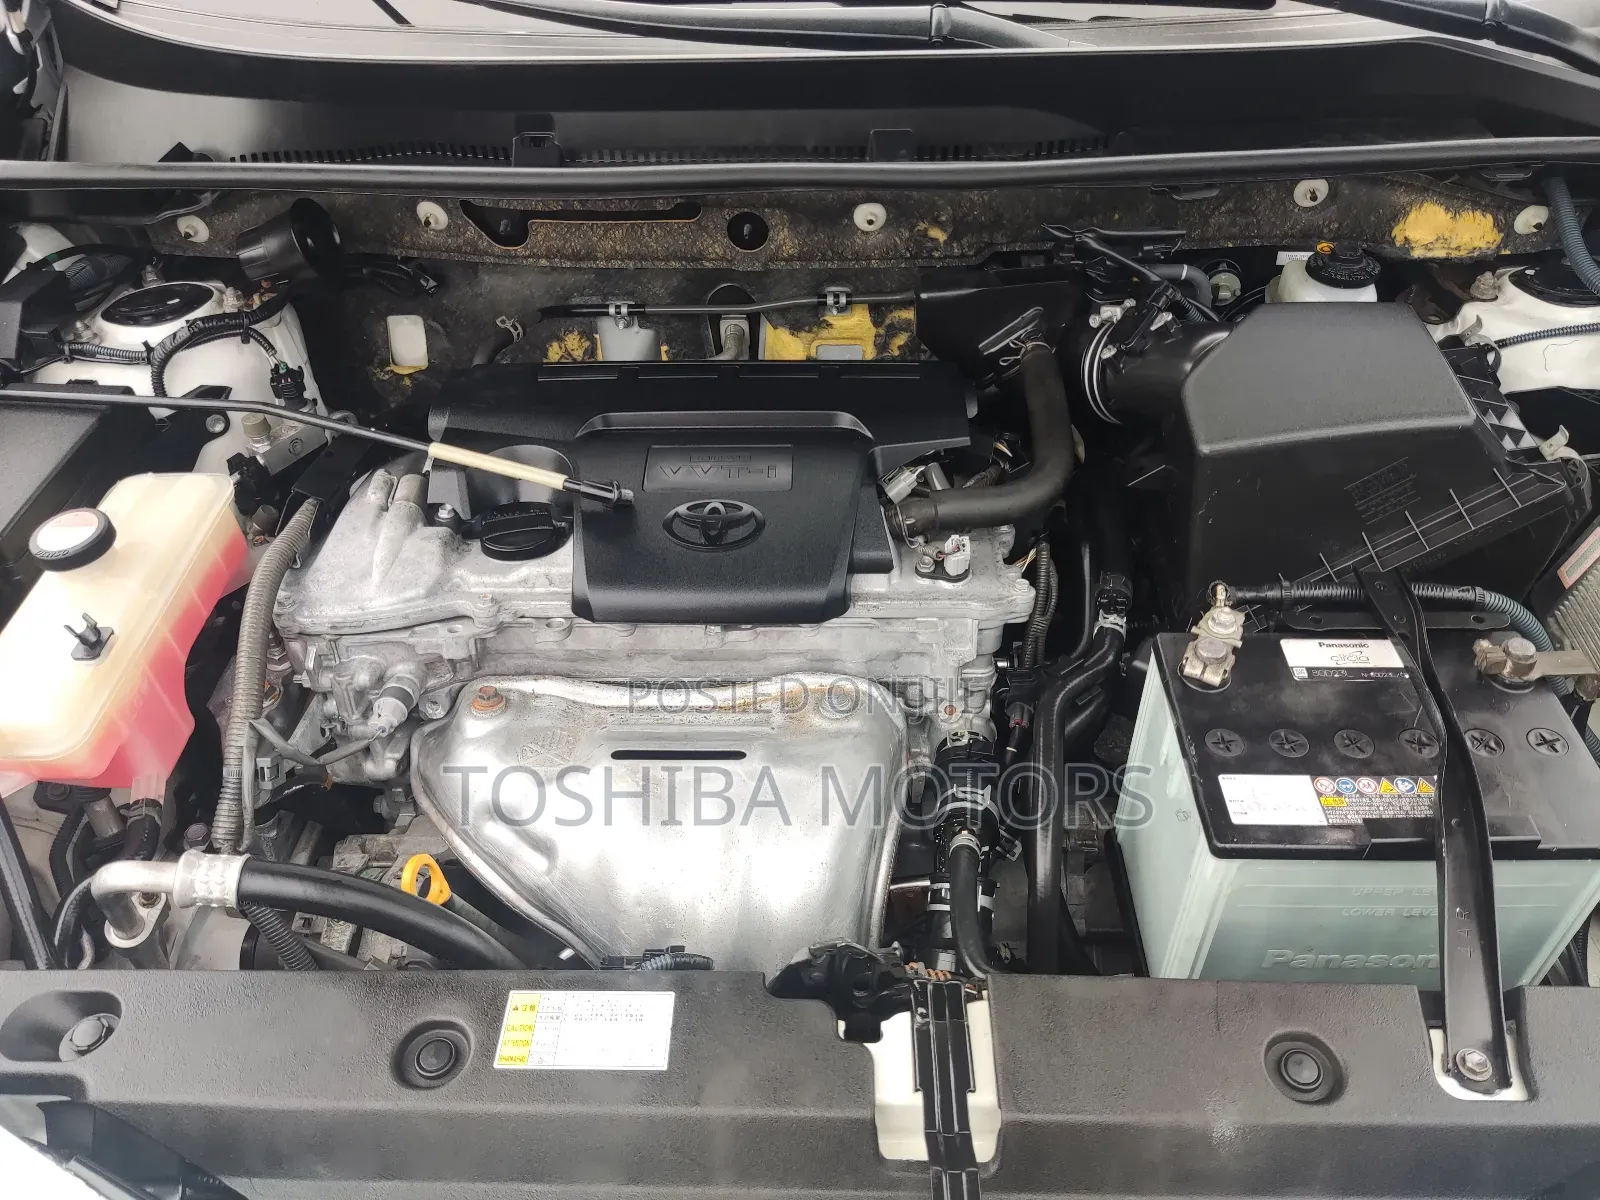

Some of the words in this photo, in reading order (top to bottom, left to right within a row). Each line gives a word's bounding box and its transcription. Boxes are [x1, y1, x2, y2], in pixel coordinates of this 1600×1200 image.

[1317, 641, 1370, 649] Panasonic
[1351, 887, 1404, 897] UPPER
[1341, 907, 1396, 917] LOWER
[1402, 907, 1439, 917] LEVE
[1261, 949, 1440, 969] Panason
[506, 1024, 534, 1032] CAUTION
